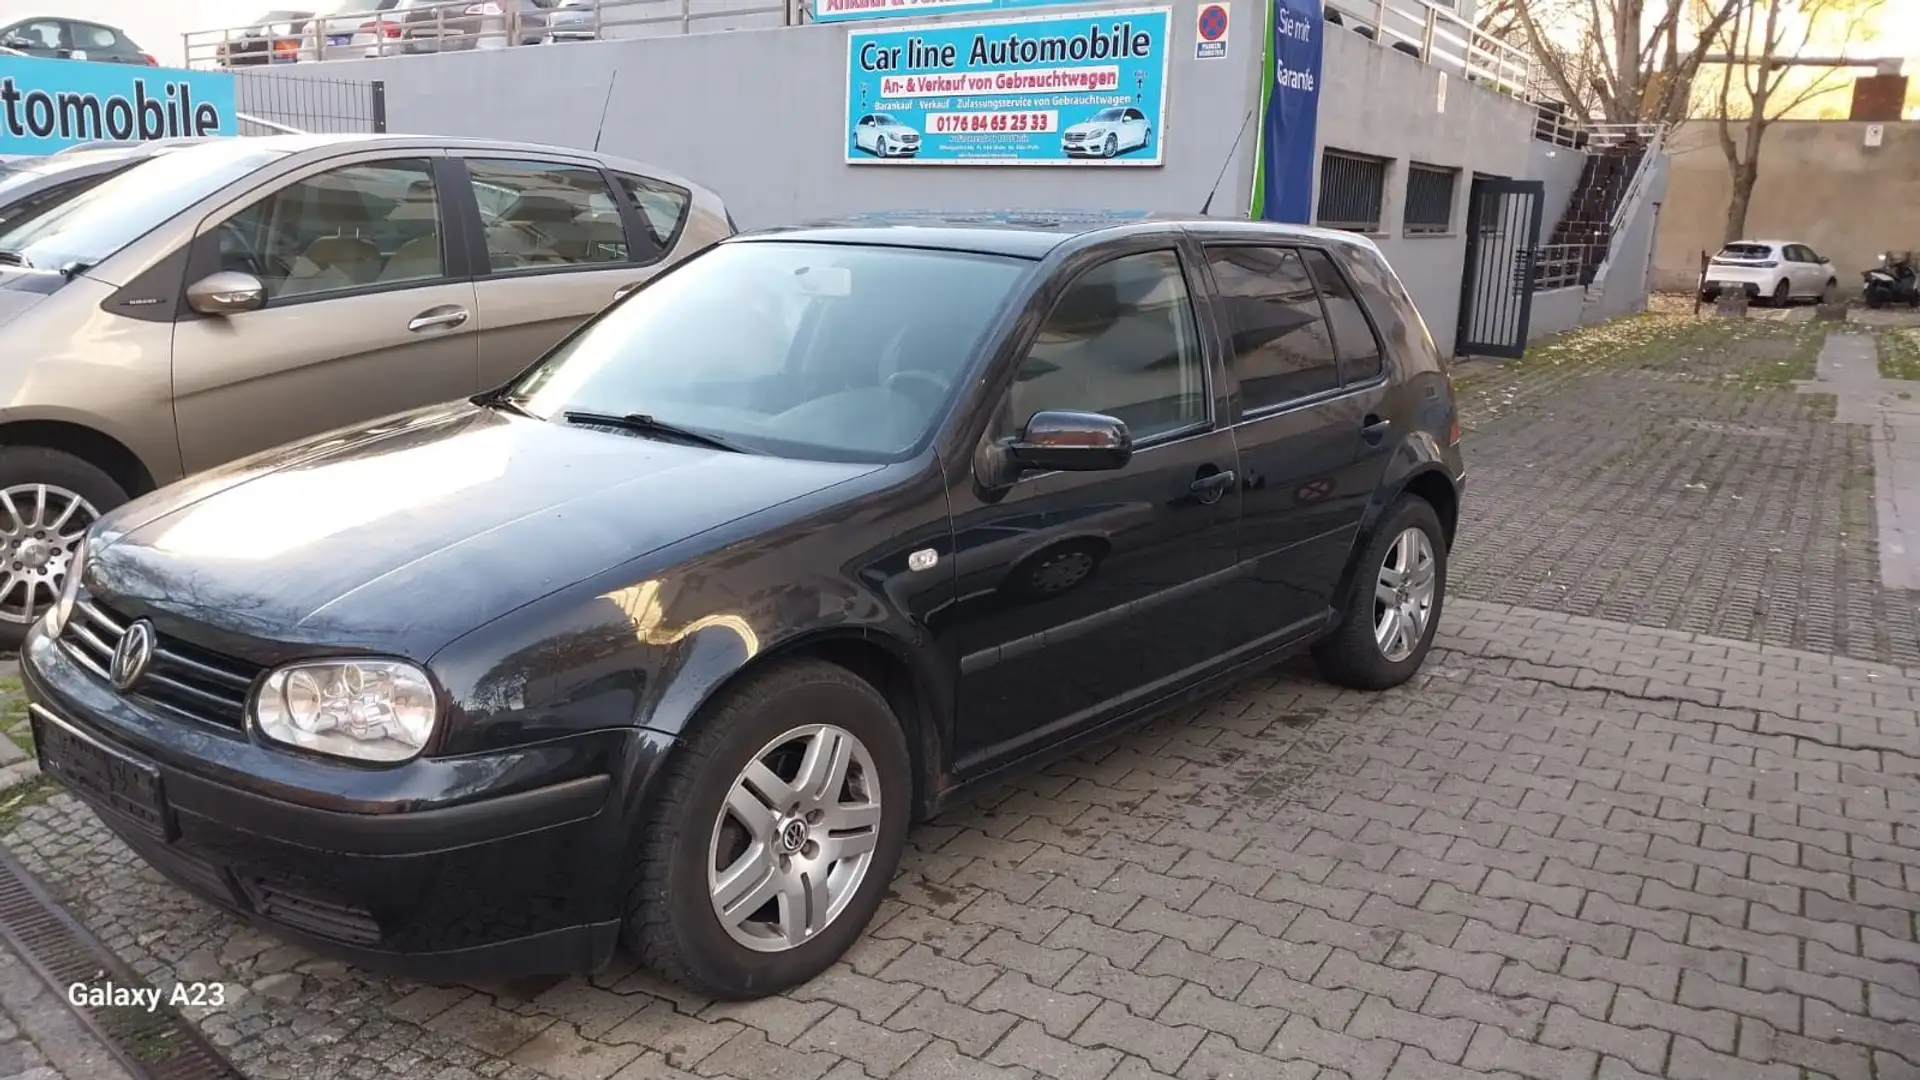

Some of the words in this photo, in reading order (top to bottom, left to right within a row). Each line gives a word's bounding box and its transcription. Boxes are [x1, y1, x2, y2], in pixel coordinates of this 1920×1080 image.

[1277, 7, 1293, 37] Sie
[1294, 17, 1310, 42] mit
[860, 43, 901, 71] Car
[908, 40, 956, 69] line
[969, 24, 1151, 66] Automobile
[883, 79, 904, 93] An-
[906, 77, 916, 92] &
[918, 75, 965, 92] Verkauf
[968, 78, 993, 90] von
[996, 71, 1116, 89] Gebrauchtwagen
[1, 79, 219, 140] tomobile
[1052, 95, 1131, 107] Gebrauchtwagen
[937, 115, 968, 131] 0176
[971, 115, 988, 131] 84
[991, 115, 1007, 131] 65
[1010, 114, 1027, 131] 25
[1031, 114, 1047, 130] 33
